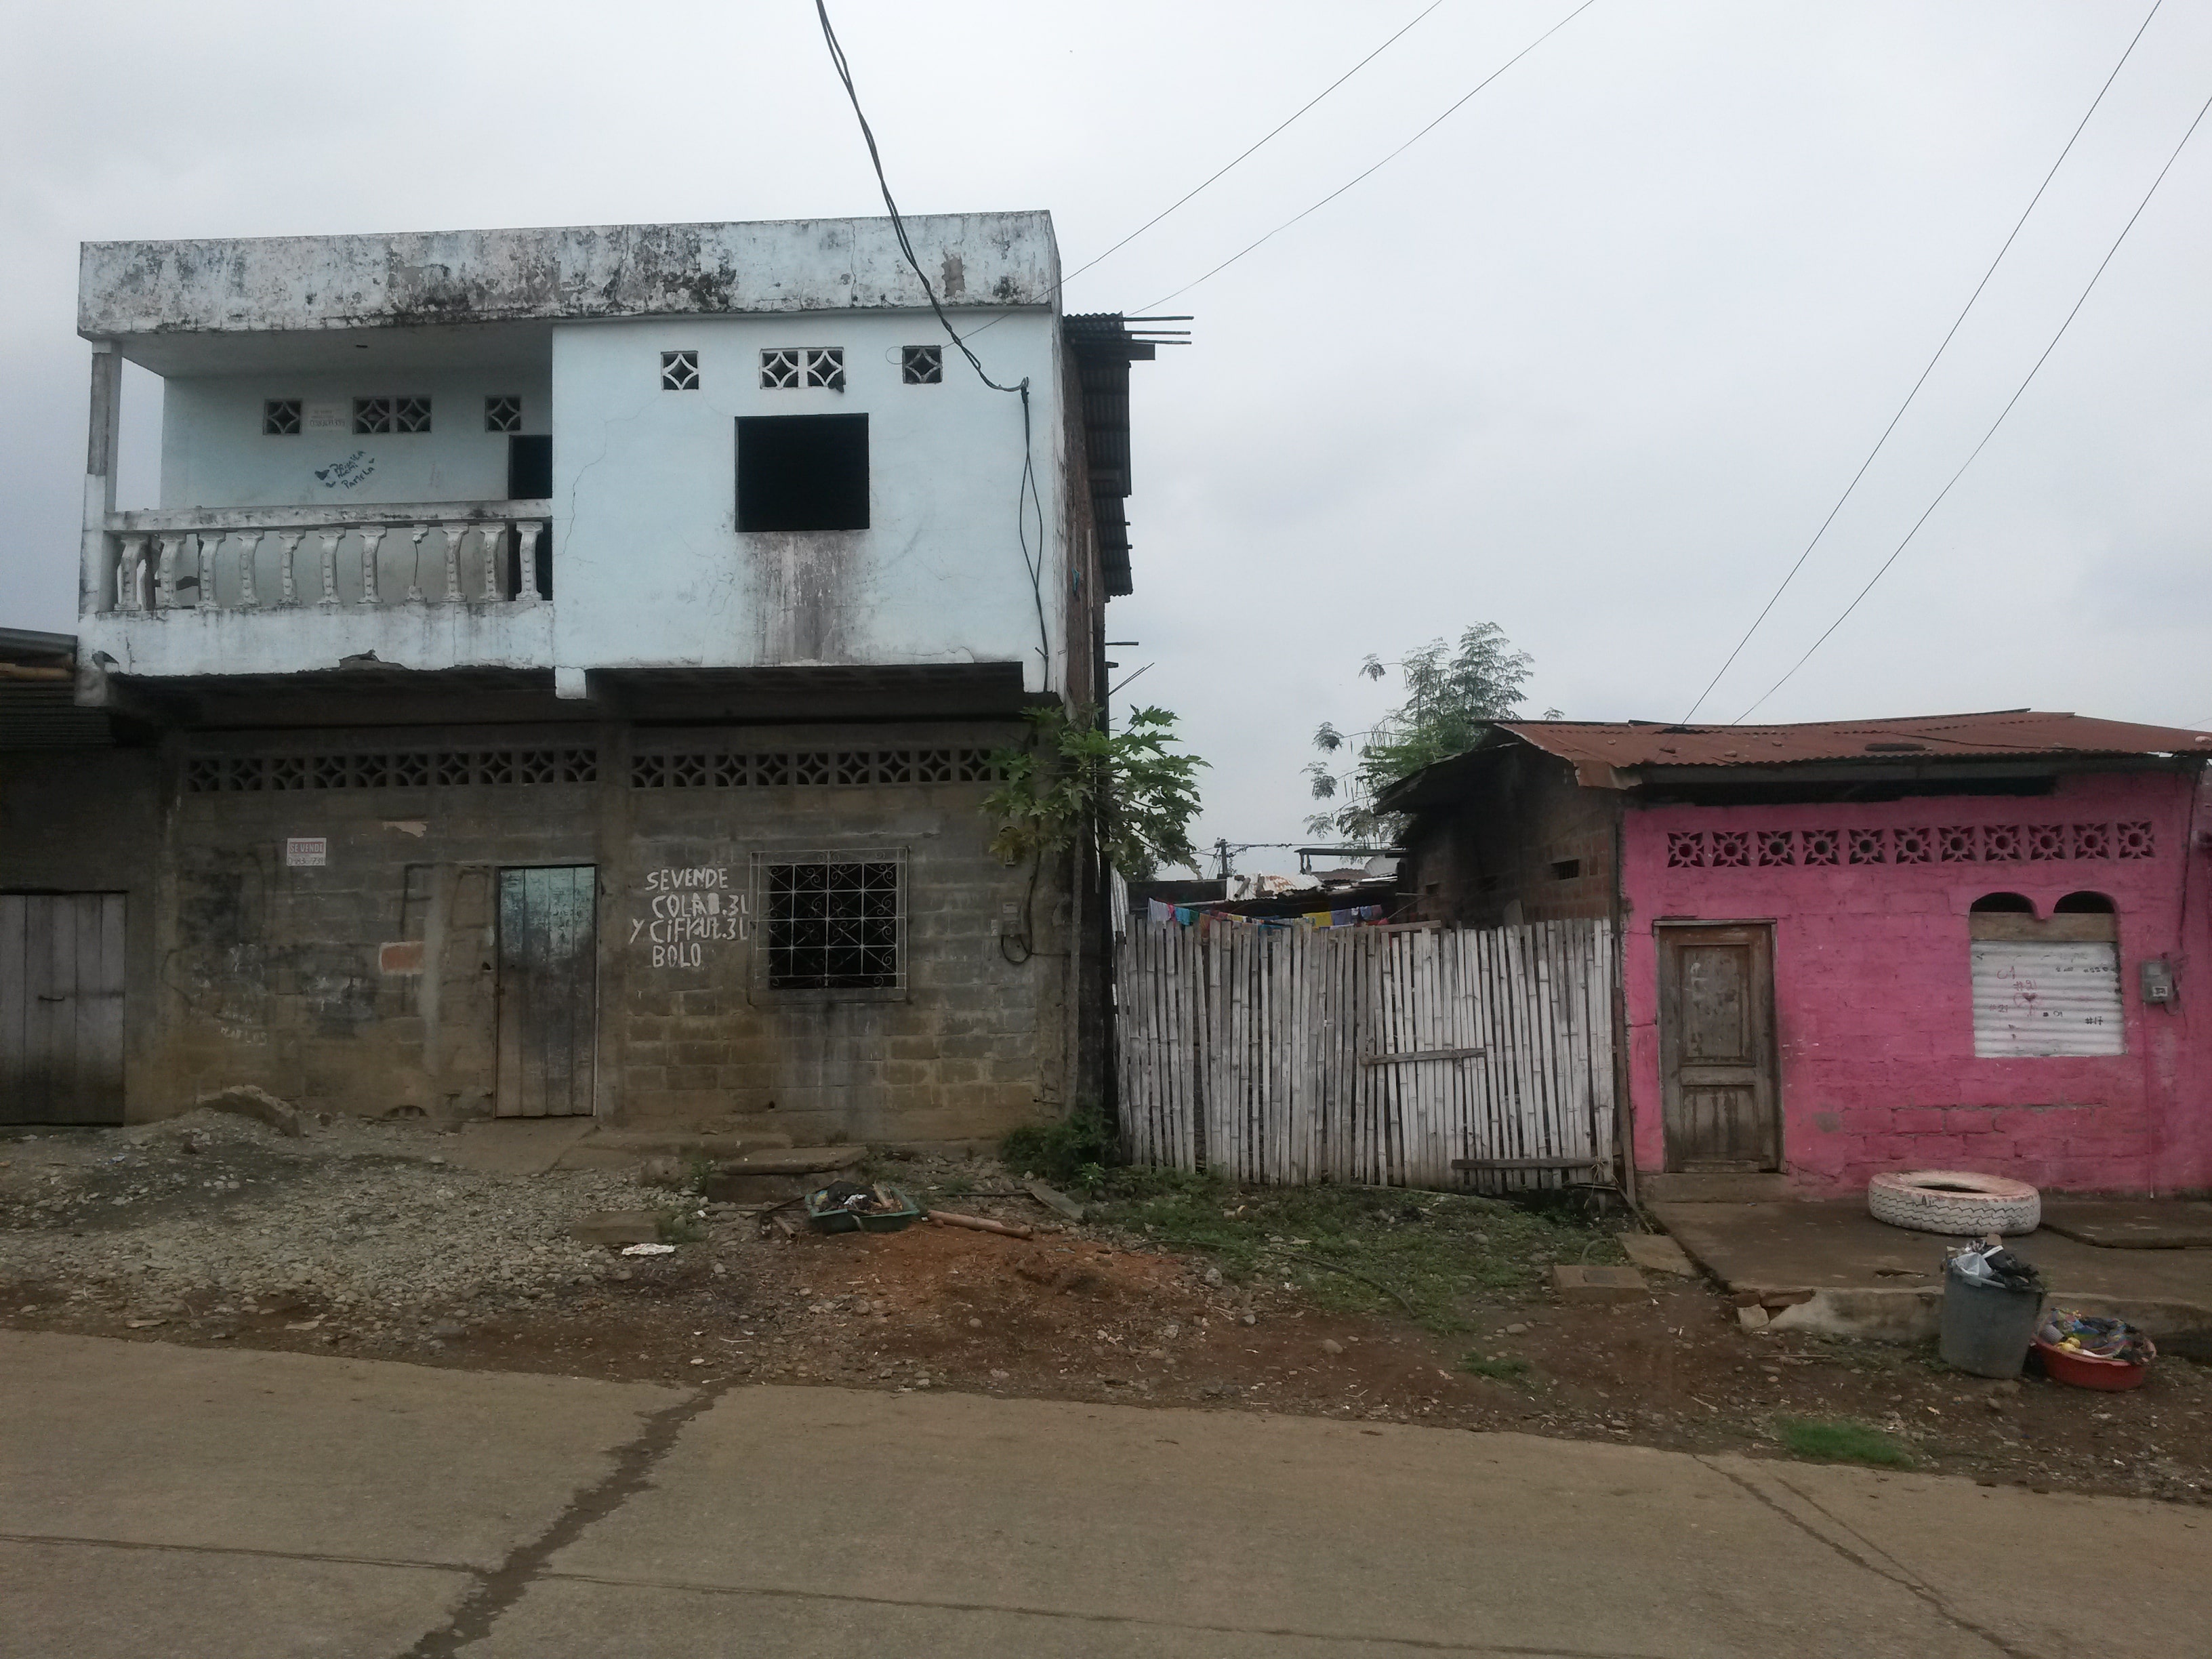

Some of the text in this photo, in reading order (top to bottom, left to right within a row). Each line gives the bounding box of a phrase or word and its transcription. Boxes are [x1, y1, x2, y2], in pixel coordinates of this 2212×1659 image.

[289, 843, 323, 853] SE VENDE
[651, 892, 707, 918] COLA
[628, 918, 644, 945] Y
[653, 941, 701, 968] BOLO
